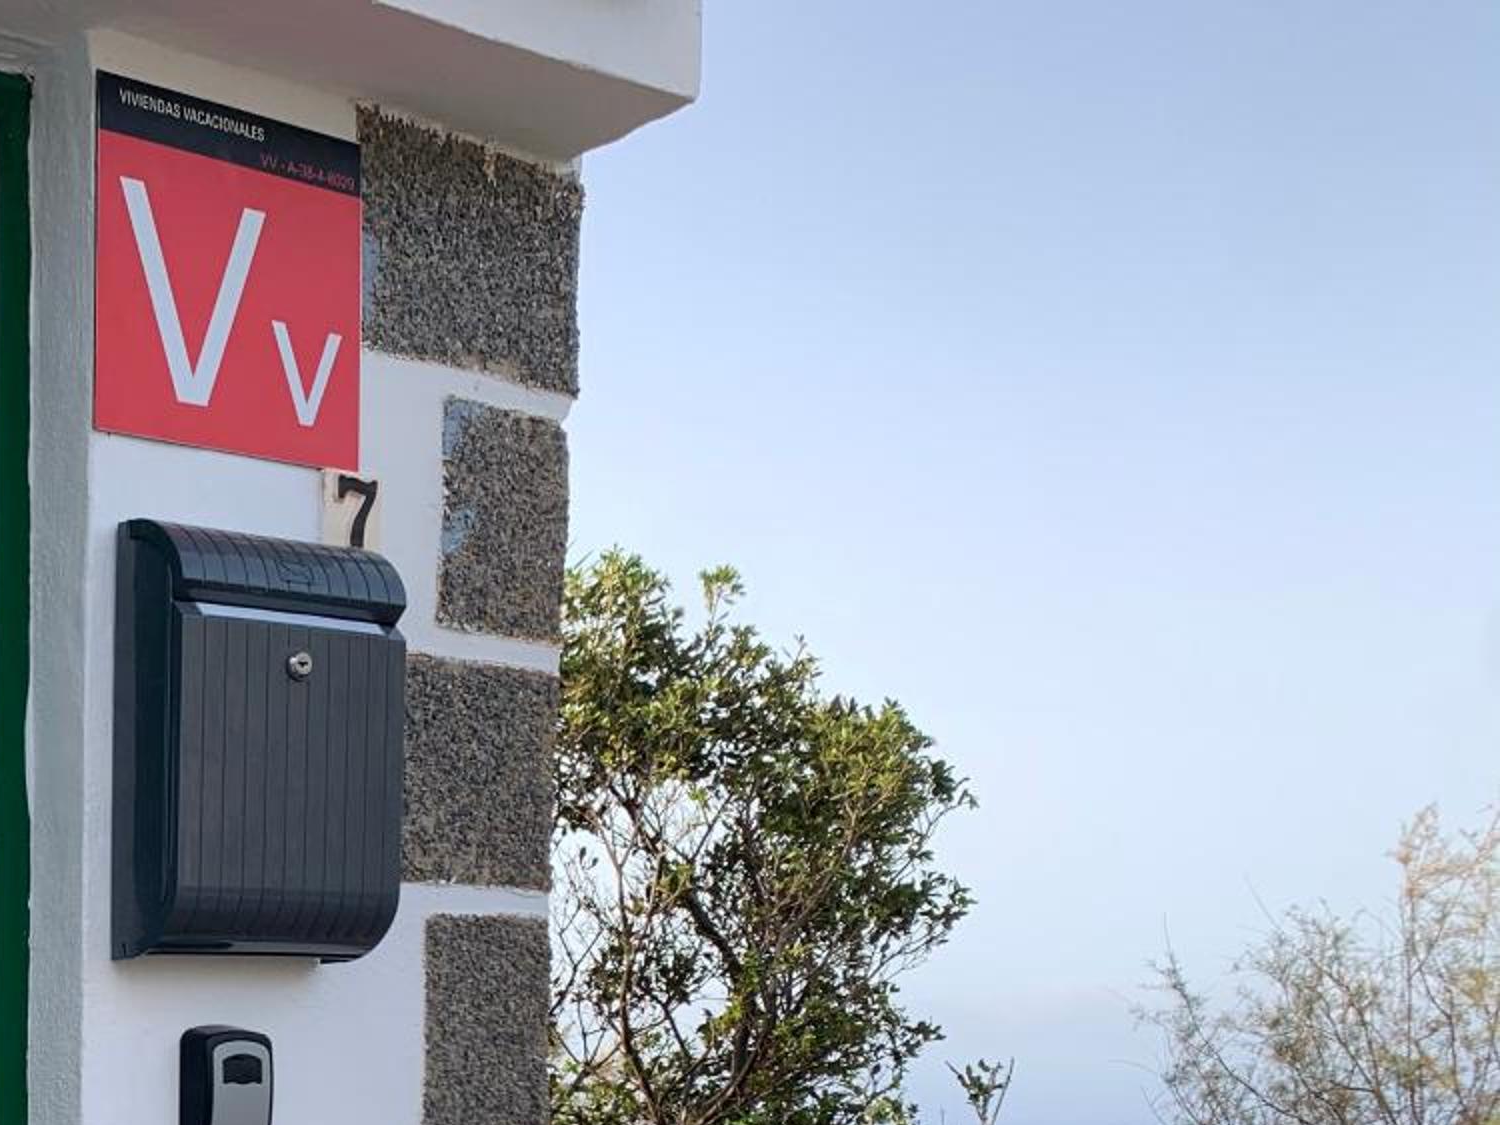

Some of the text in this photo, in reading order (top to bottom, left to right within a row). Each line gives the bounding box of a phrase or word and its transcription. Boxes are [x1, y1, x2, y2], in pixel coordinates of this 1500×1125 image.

[119, 88, 265, 142] VIVIENDAS VACACIONALES
[338, 474, 377, 547] 7
